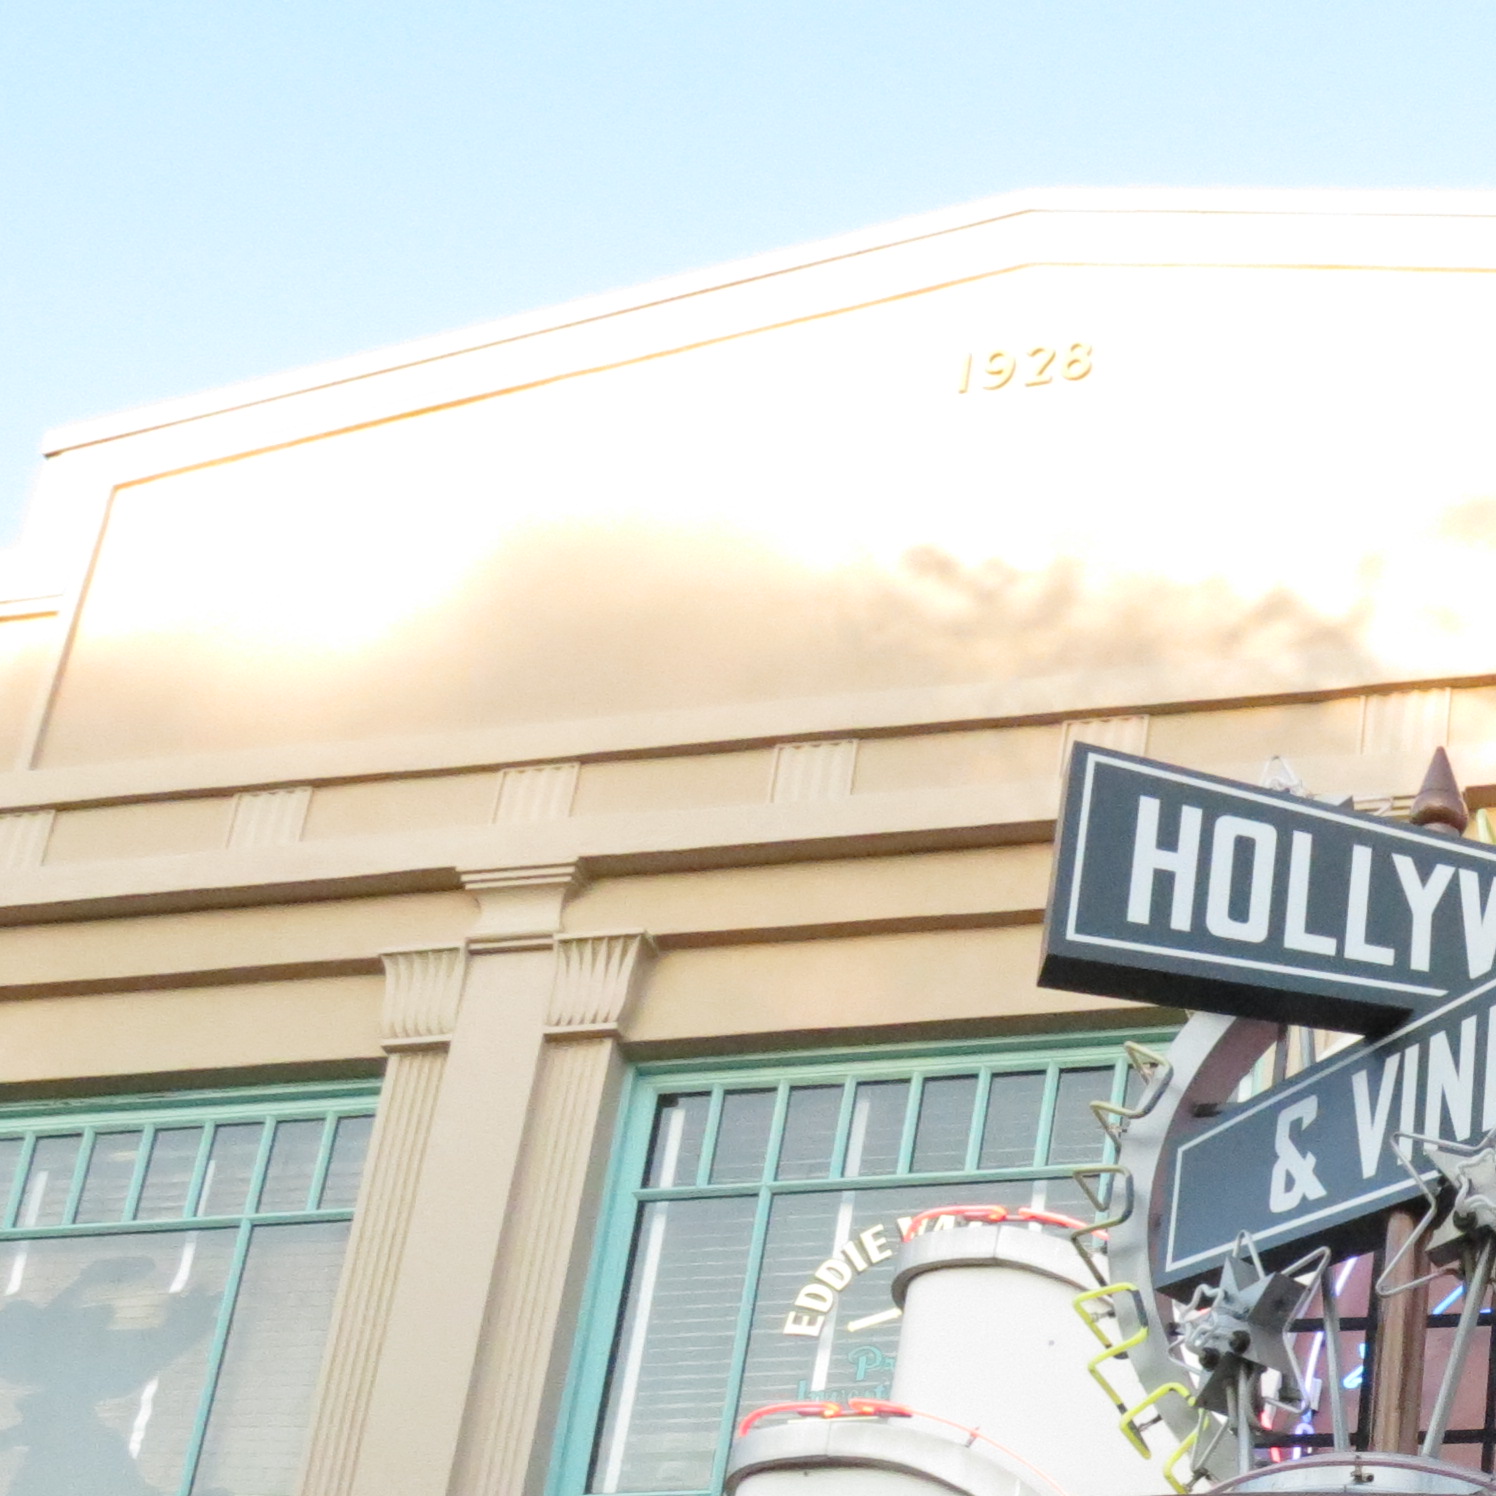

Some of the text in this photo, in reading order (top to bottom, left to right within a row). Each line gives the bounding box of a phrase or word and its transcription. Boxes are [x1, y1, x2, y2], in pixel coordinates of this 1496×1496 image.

[957, 341, 1093, 395] 1928
[1268, 1094, 1330, 1214] &
[783, 1223, 893, 1338] EDDIE
